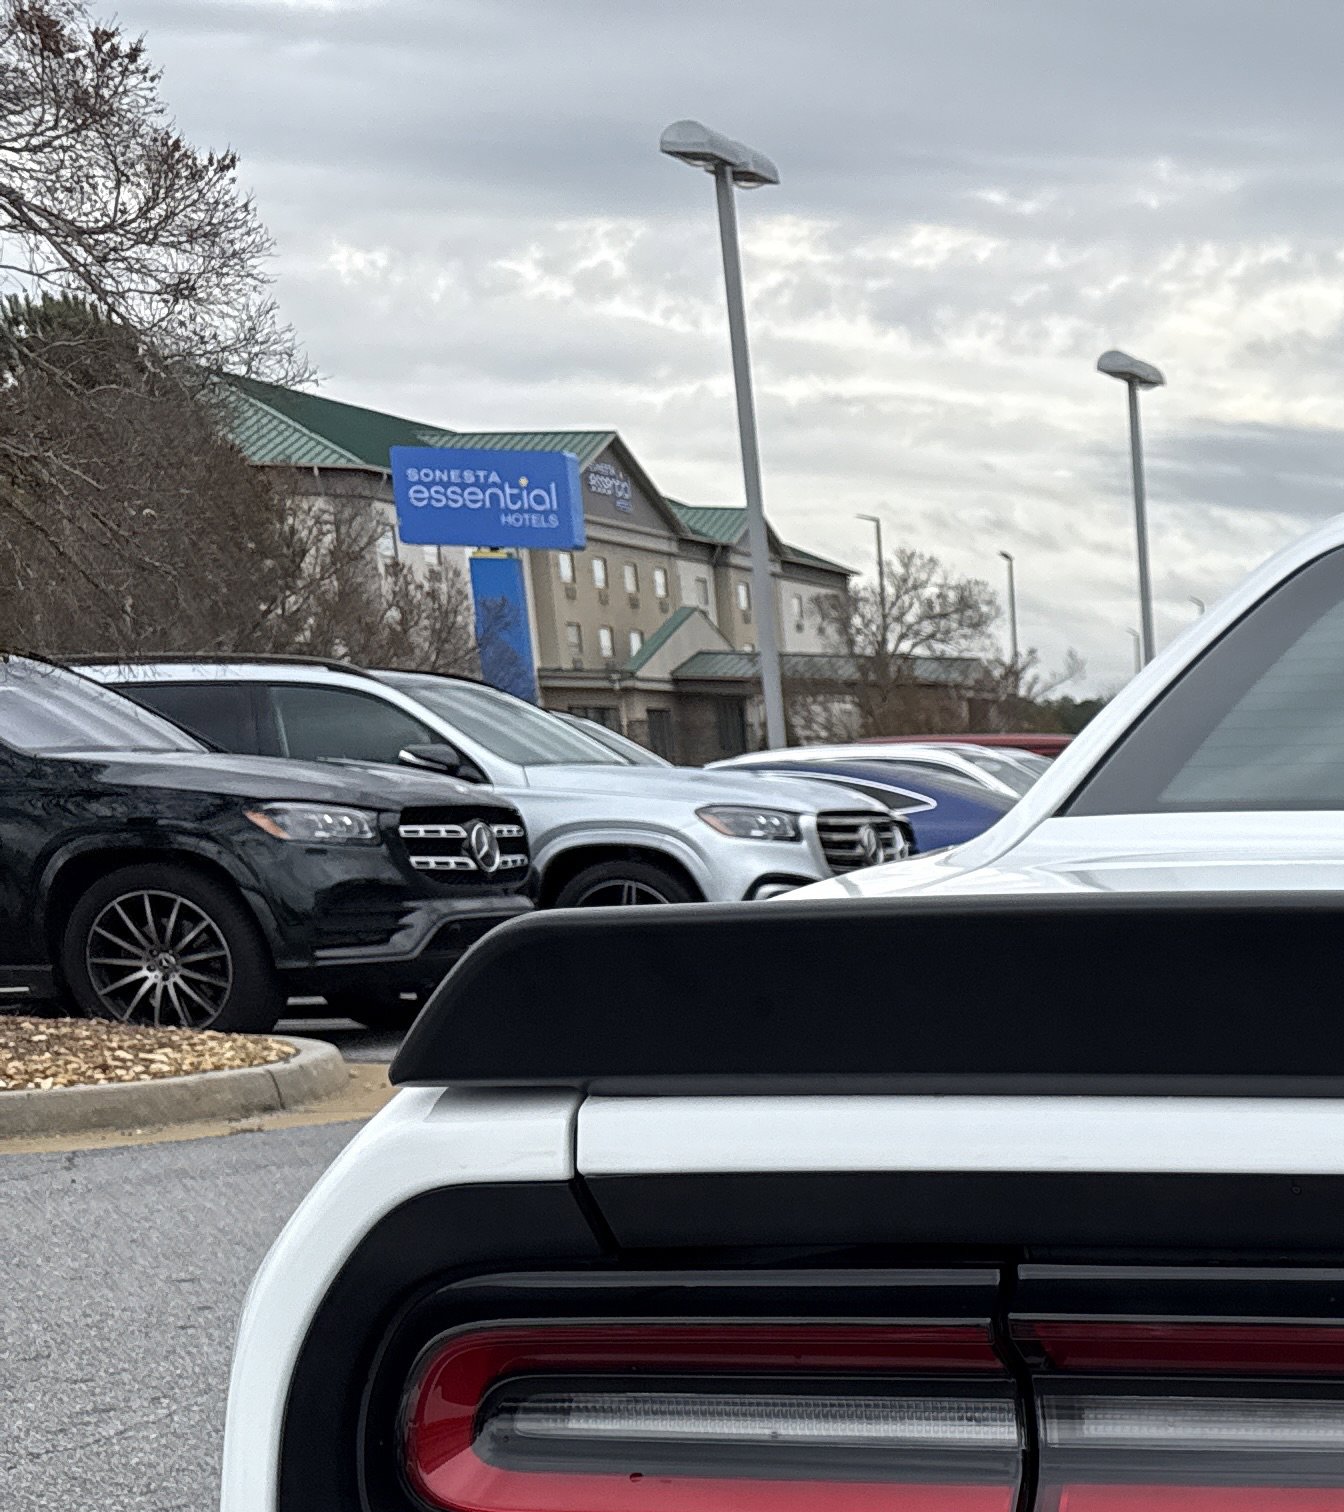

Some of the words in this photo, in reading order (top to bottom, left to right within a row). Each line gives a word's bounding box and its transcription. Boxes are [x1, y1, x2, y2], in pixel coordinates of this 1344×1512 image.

[406, 467, 502, 484] SONESTA
[408, 476, 559, 512] essential
[501, 512, 560, 529] HOTELS
